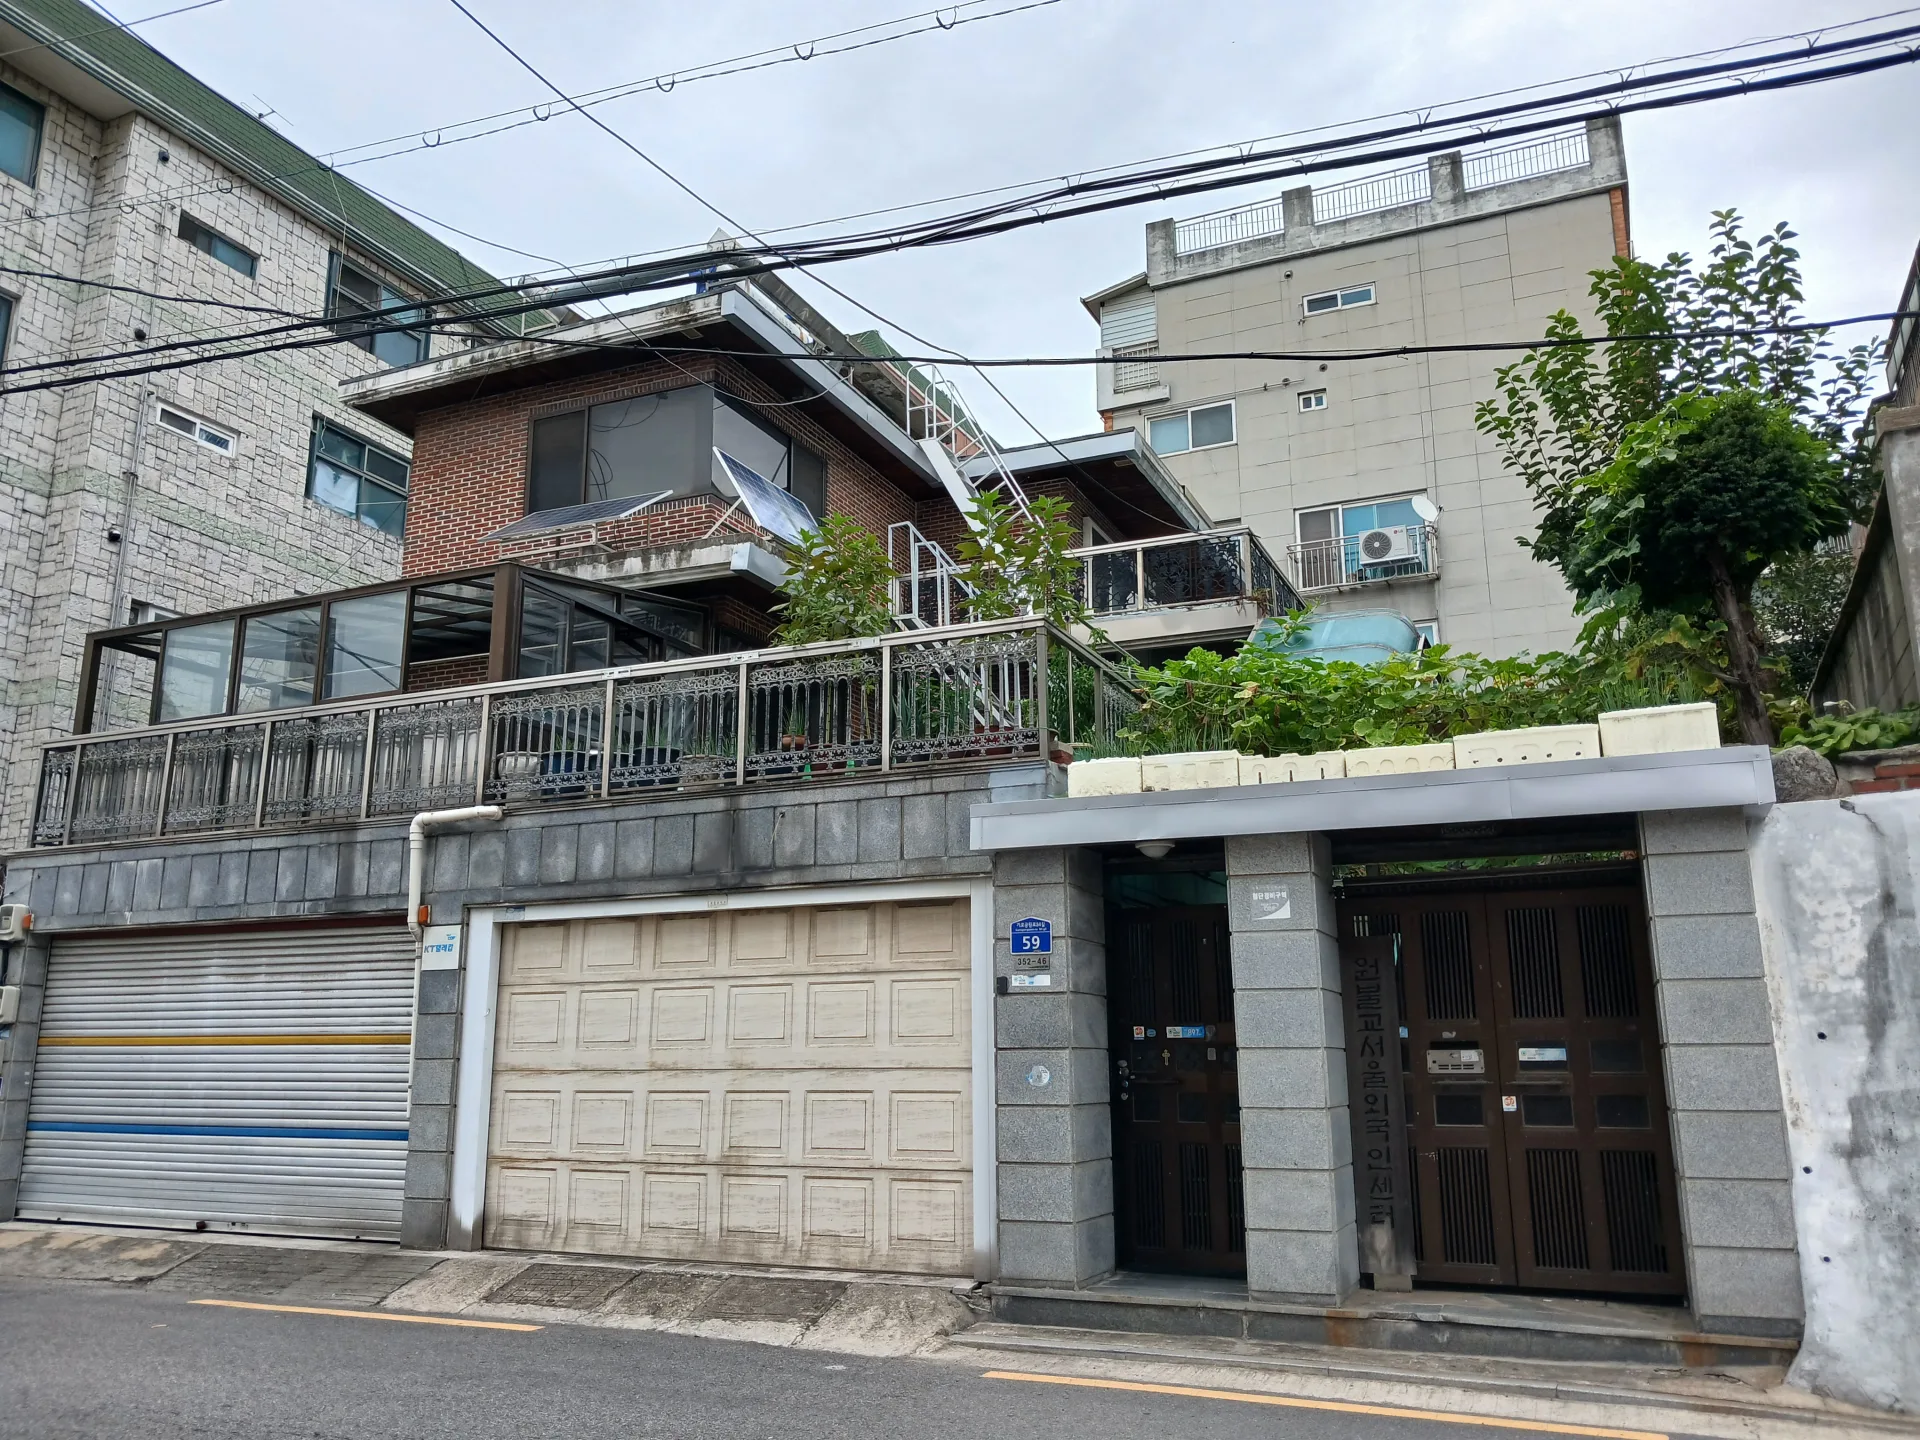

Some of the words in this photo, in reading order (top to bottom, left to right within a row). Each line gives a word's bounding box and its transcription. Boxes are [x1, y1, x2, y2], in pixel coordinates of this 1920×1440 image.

[1022, 936, 1040, 950] 59
[424, 944, 454, 953] KT텔레캅
[1017, 957, 1047, 966] 352-46
